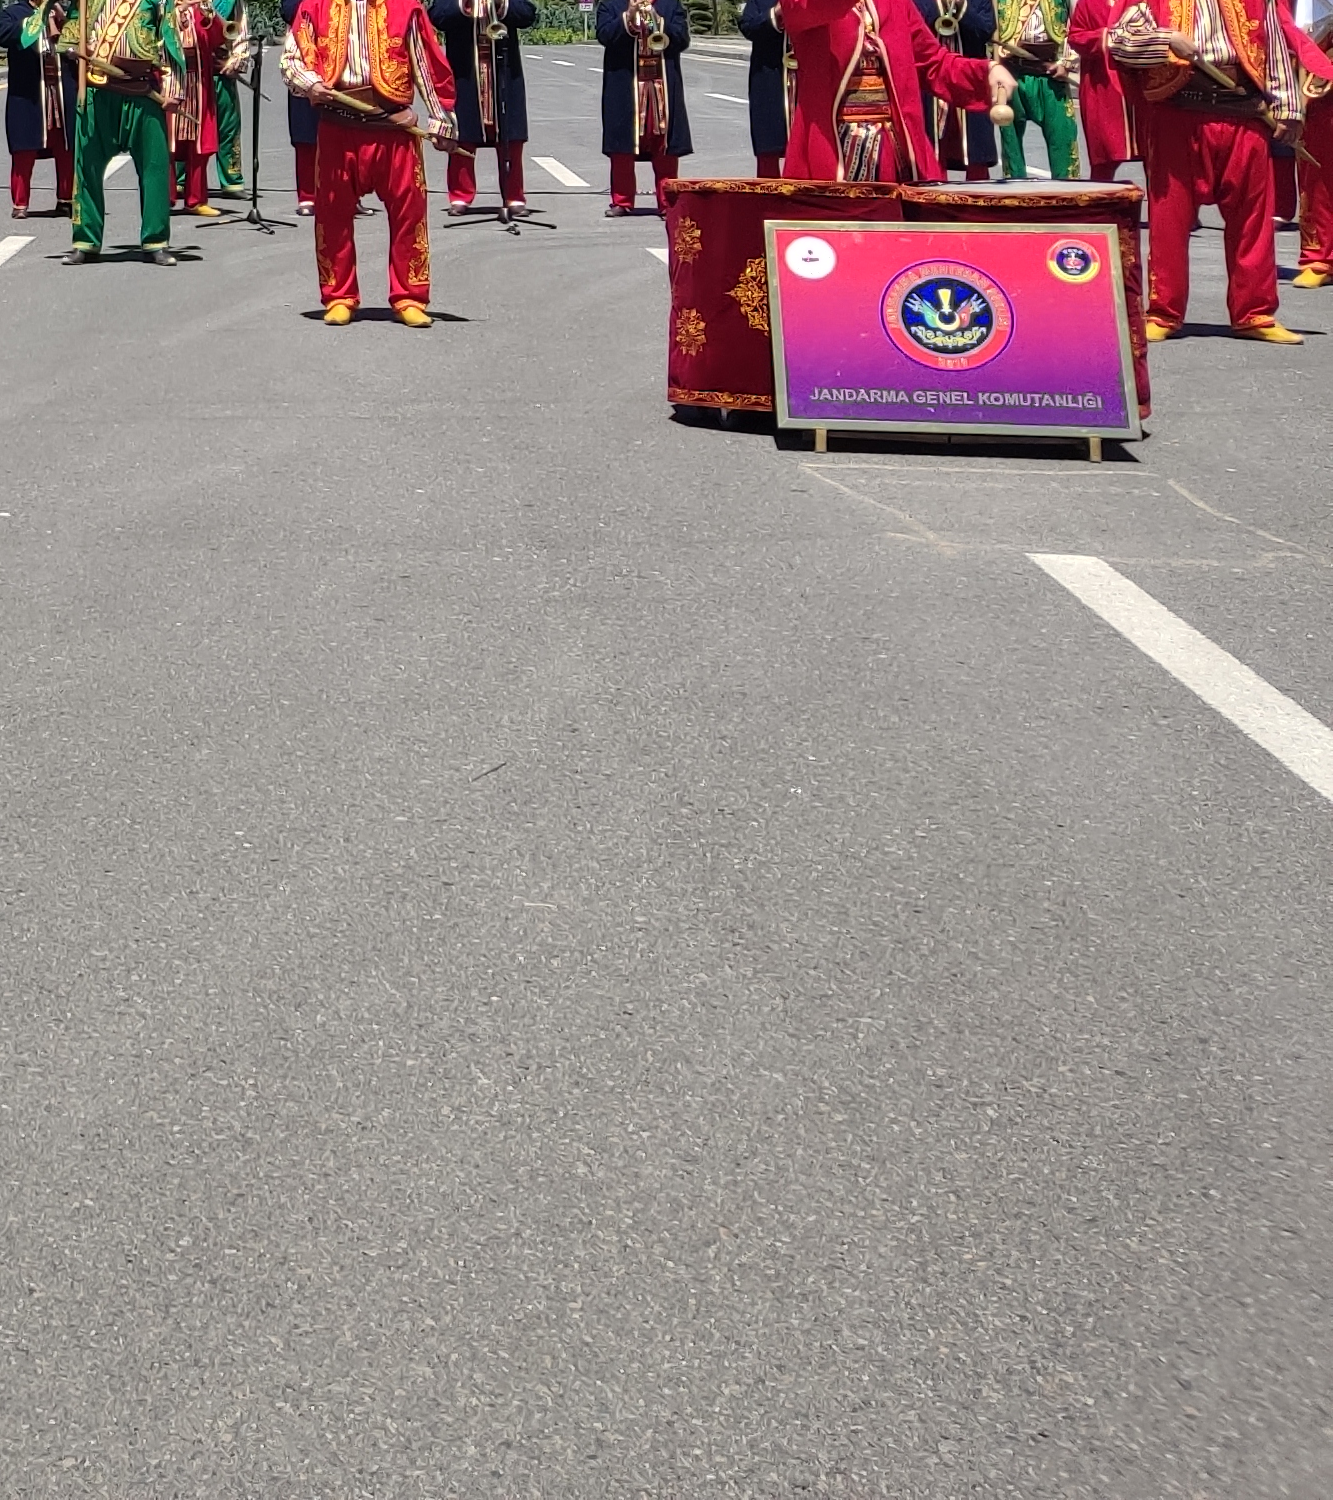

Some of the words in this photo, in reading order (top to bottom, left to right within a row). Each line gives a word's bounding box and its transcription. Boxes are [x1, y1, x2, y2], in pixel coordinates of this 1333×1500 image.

[810, 387, 909, 403] JANDARMA
[912, 390, 973, 405] GENEL
[978, 391, 1103, 409] KOMUTANLIĞI
